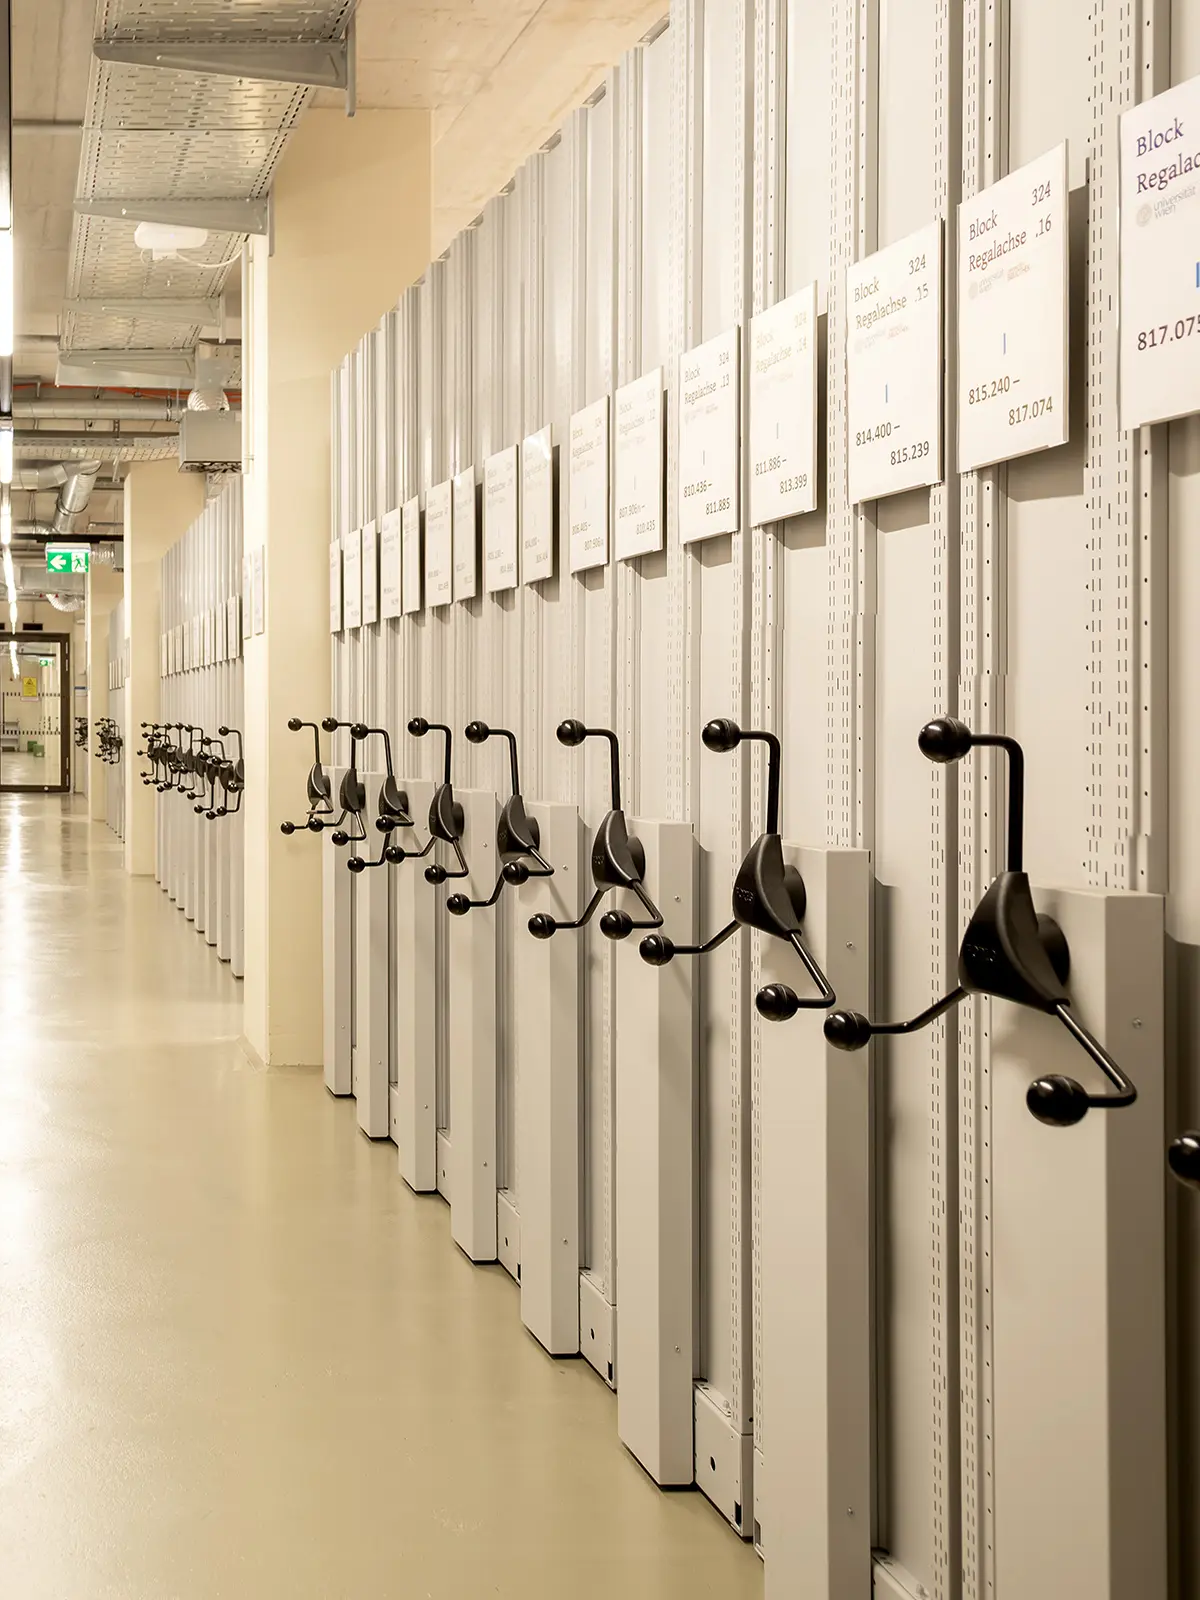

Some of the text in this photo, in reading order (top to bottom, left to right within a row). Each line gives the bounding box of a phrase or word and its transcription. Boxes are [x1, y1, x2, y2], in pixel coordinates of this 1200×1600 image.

[1135, 116, 1185, 158] Block
[968, 179, 1052, 241] Block 324
[968, 230, 1027, 272] Regalachse
[1034, 213, 1052, 239] .16
[854, 253, 927, 302] Block 324
[855, 282, 929, 330] Regalachse .15
[684, 363, 701, 383] Block
[684, 381, 717, 405] Regalachse
[1008, 395, 1053, 427] 817.074
[889, 440, 930, 466] 815.239
[779, 473, 807, 494] 813.399
[705, 497, 731, 515] 811.885
